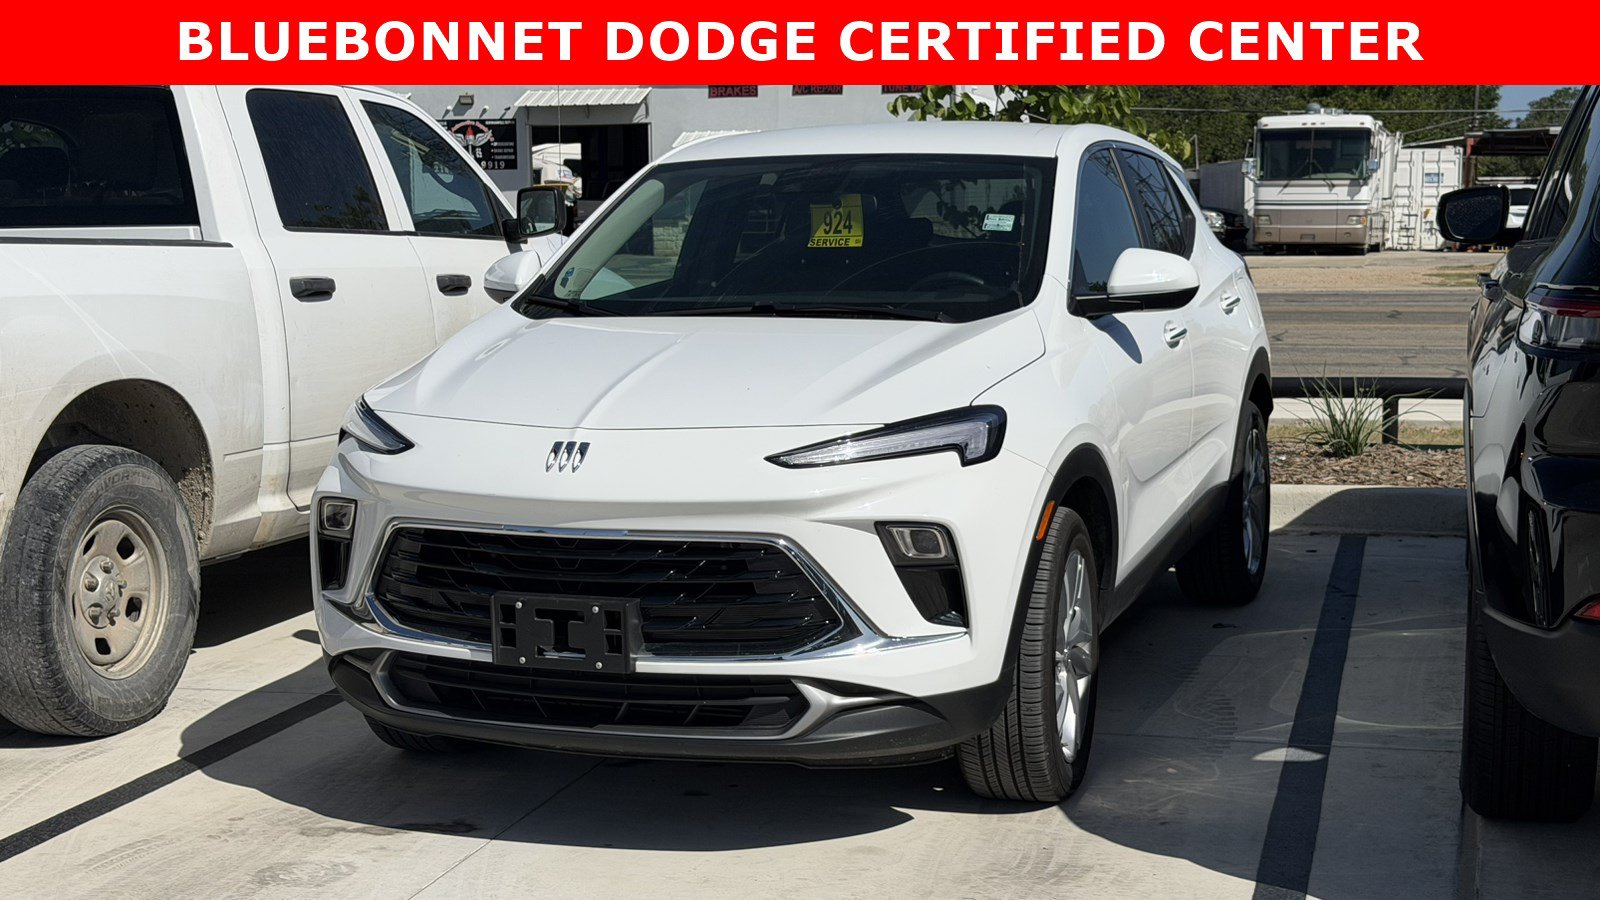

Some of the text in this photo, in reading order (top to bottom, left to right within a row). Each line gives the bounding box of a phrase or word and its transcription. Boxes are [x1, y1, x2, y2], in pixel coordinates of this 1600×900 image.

[710, 86, 756, 97] BRAKES
[811, 85, 842, 93] REPAIR
[823, 210, 853, 235] 924
[810, 238, 850, 247] SERVICE
